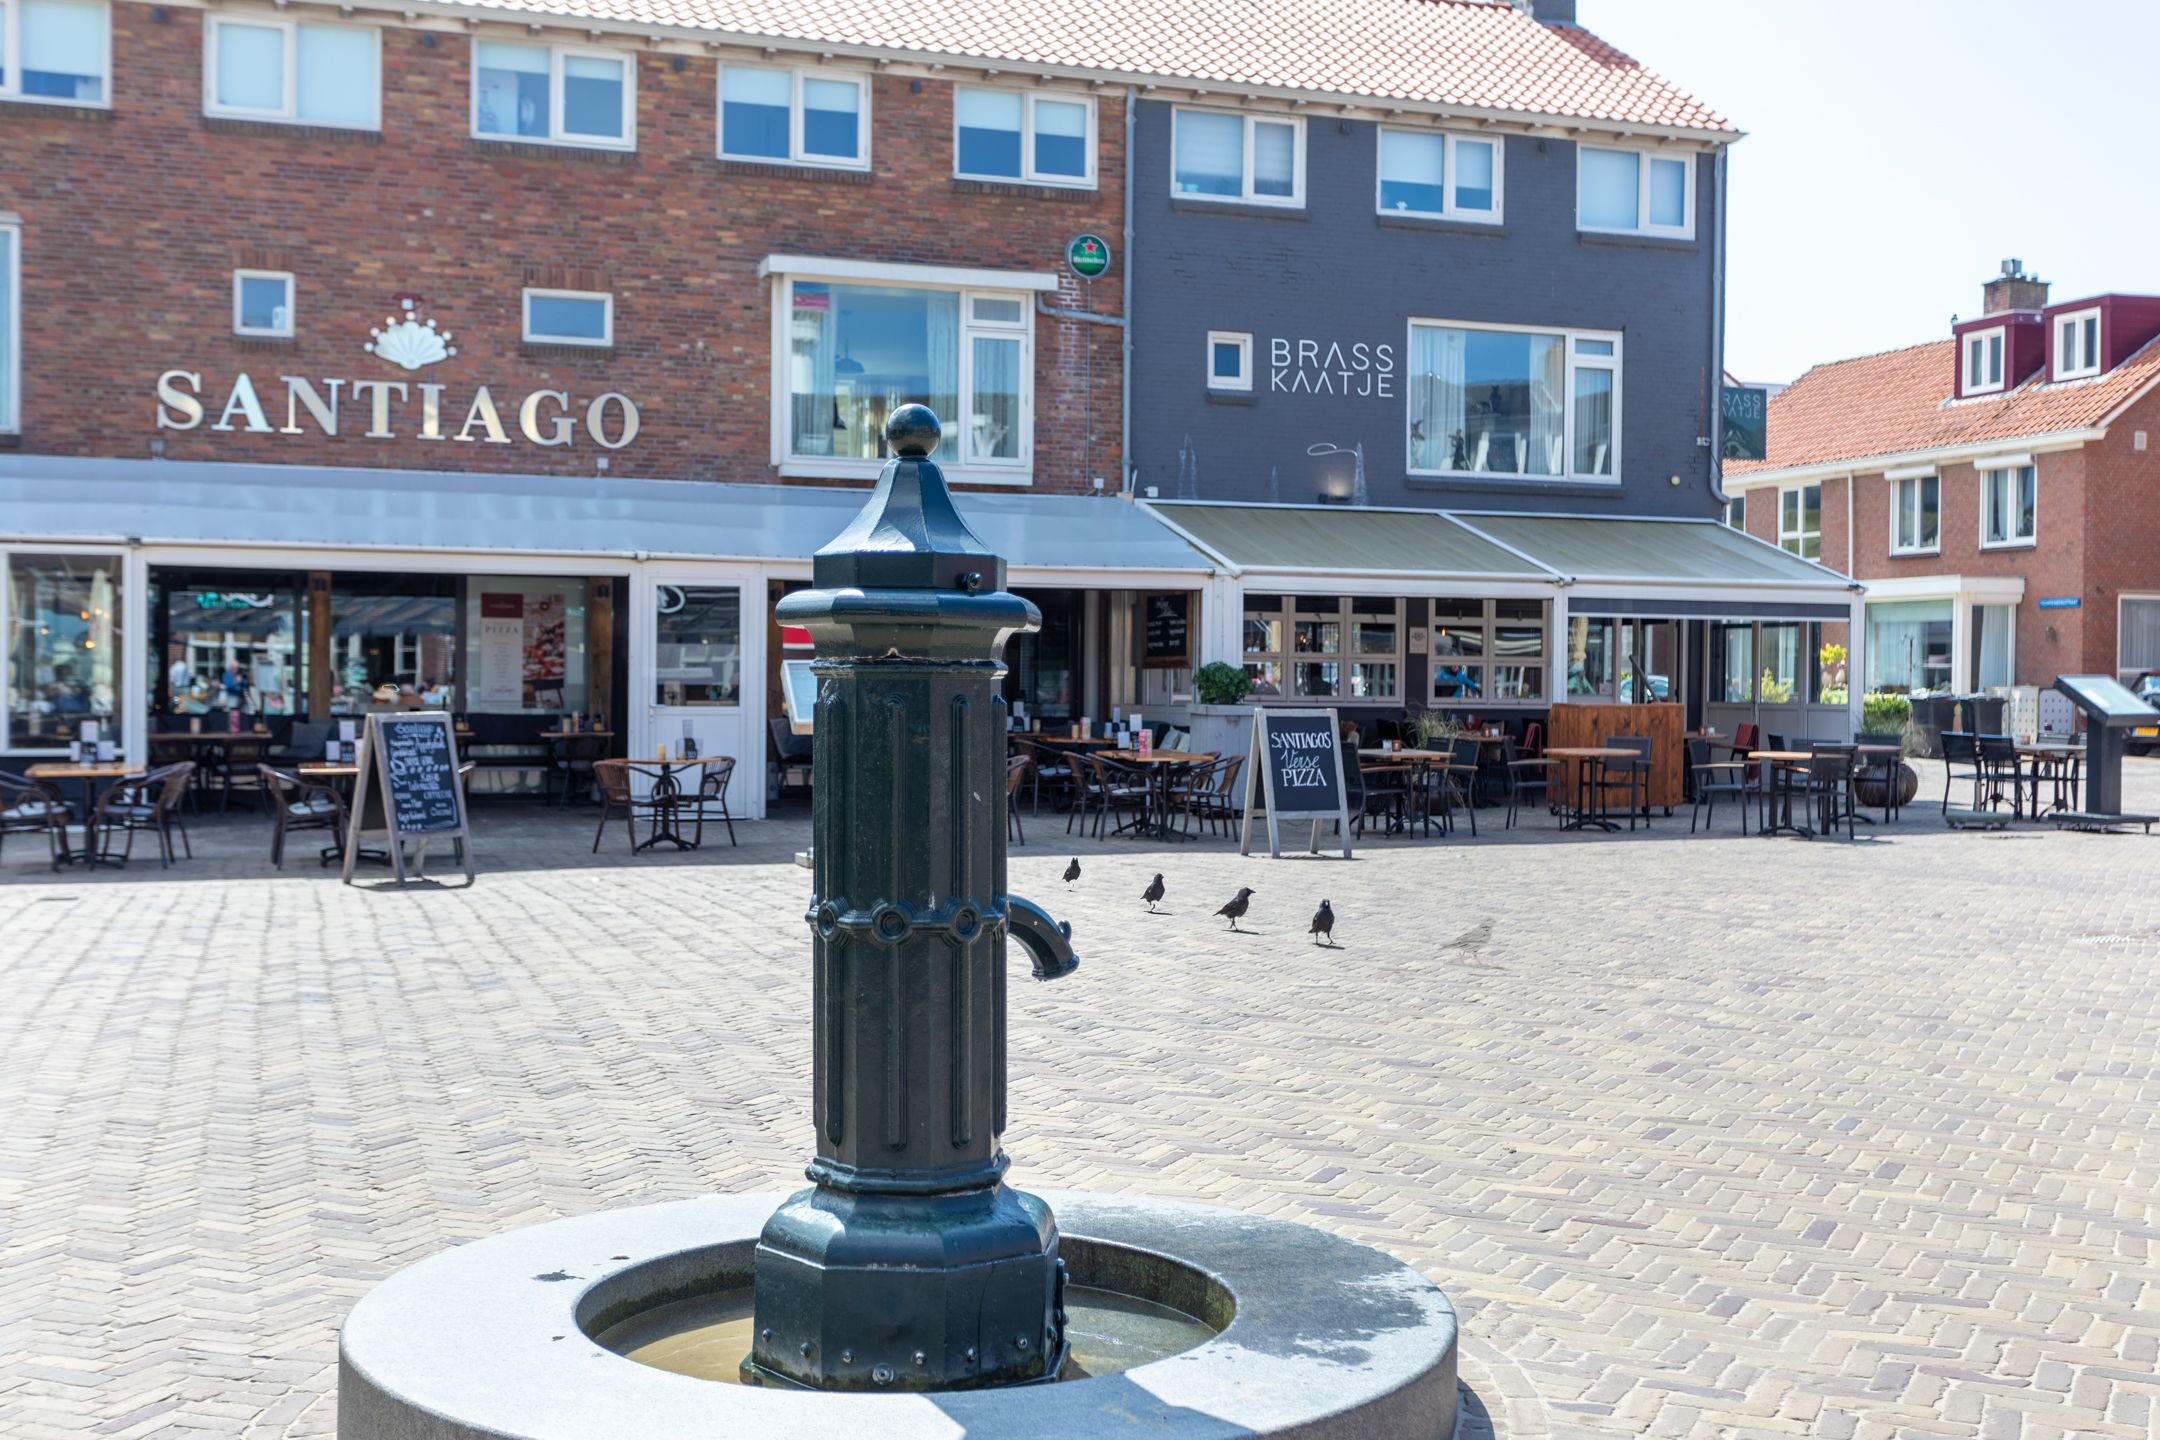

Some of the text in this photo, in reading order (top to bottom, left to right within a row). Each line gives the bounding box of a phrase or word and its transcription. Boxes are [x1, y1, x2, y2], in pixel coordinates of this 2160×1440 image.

[1271, 338, 1394, 372] BRASS
[1271, 367, 1394, 398] KAATJE
[156, 369, 641, 449] SANTIAGO
[1723, 391, 1761, 408] RASS
[1280, 748, 1320, 769] Verse
[1281, 767, 1328, 787] PIZZA
